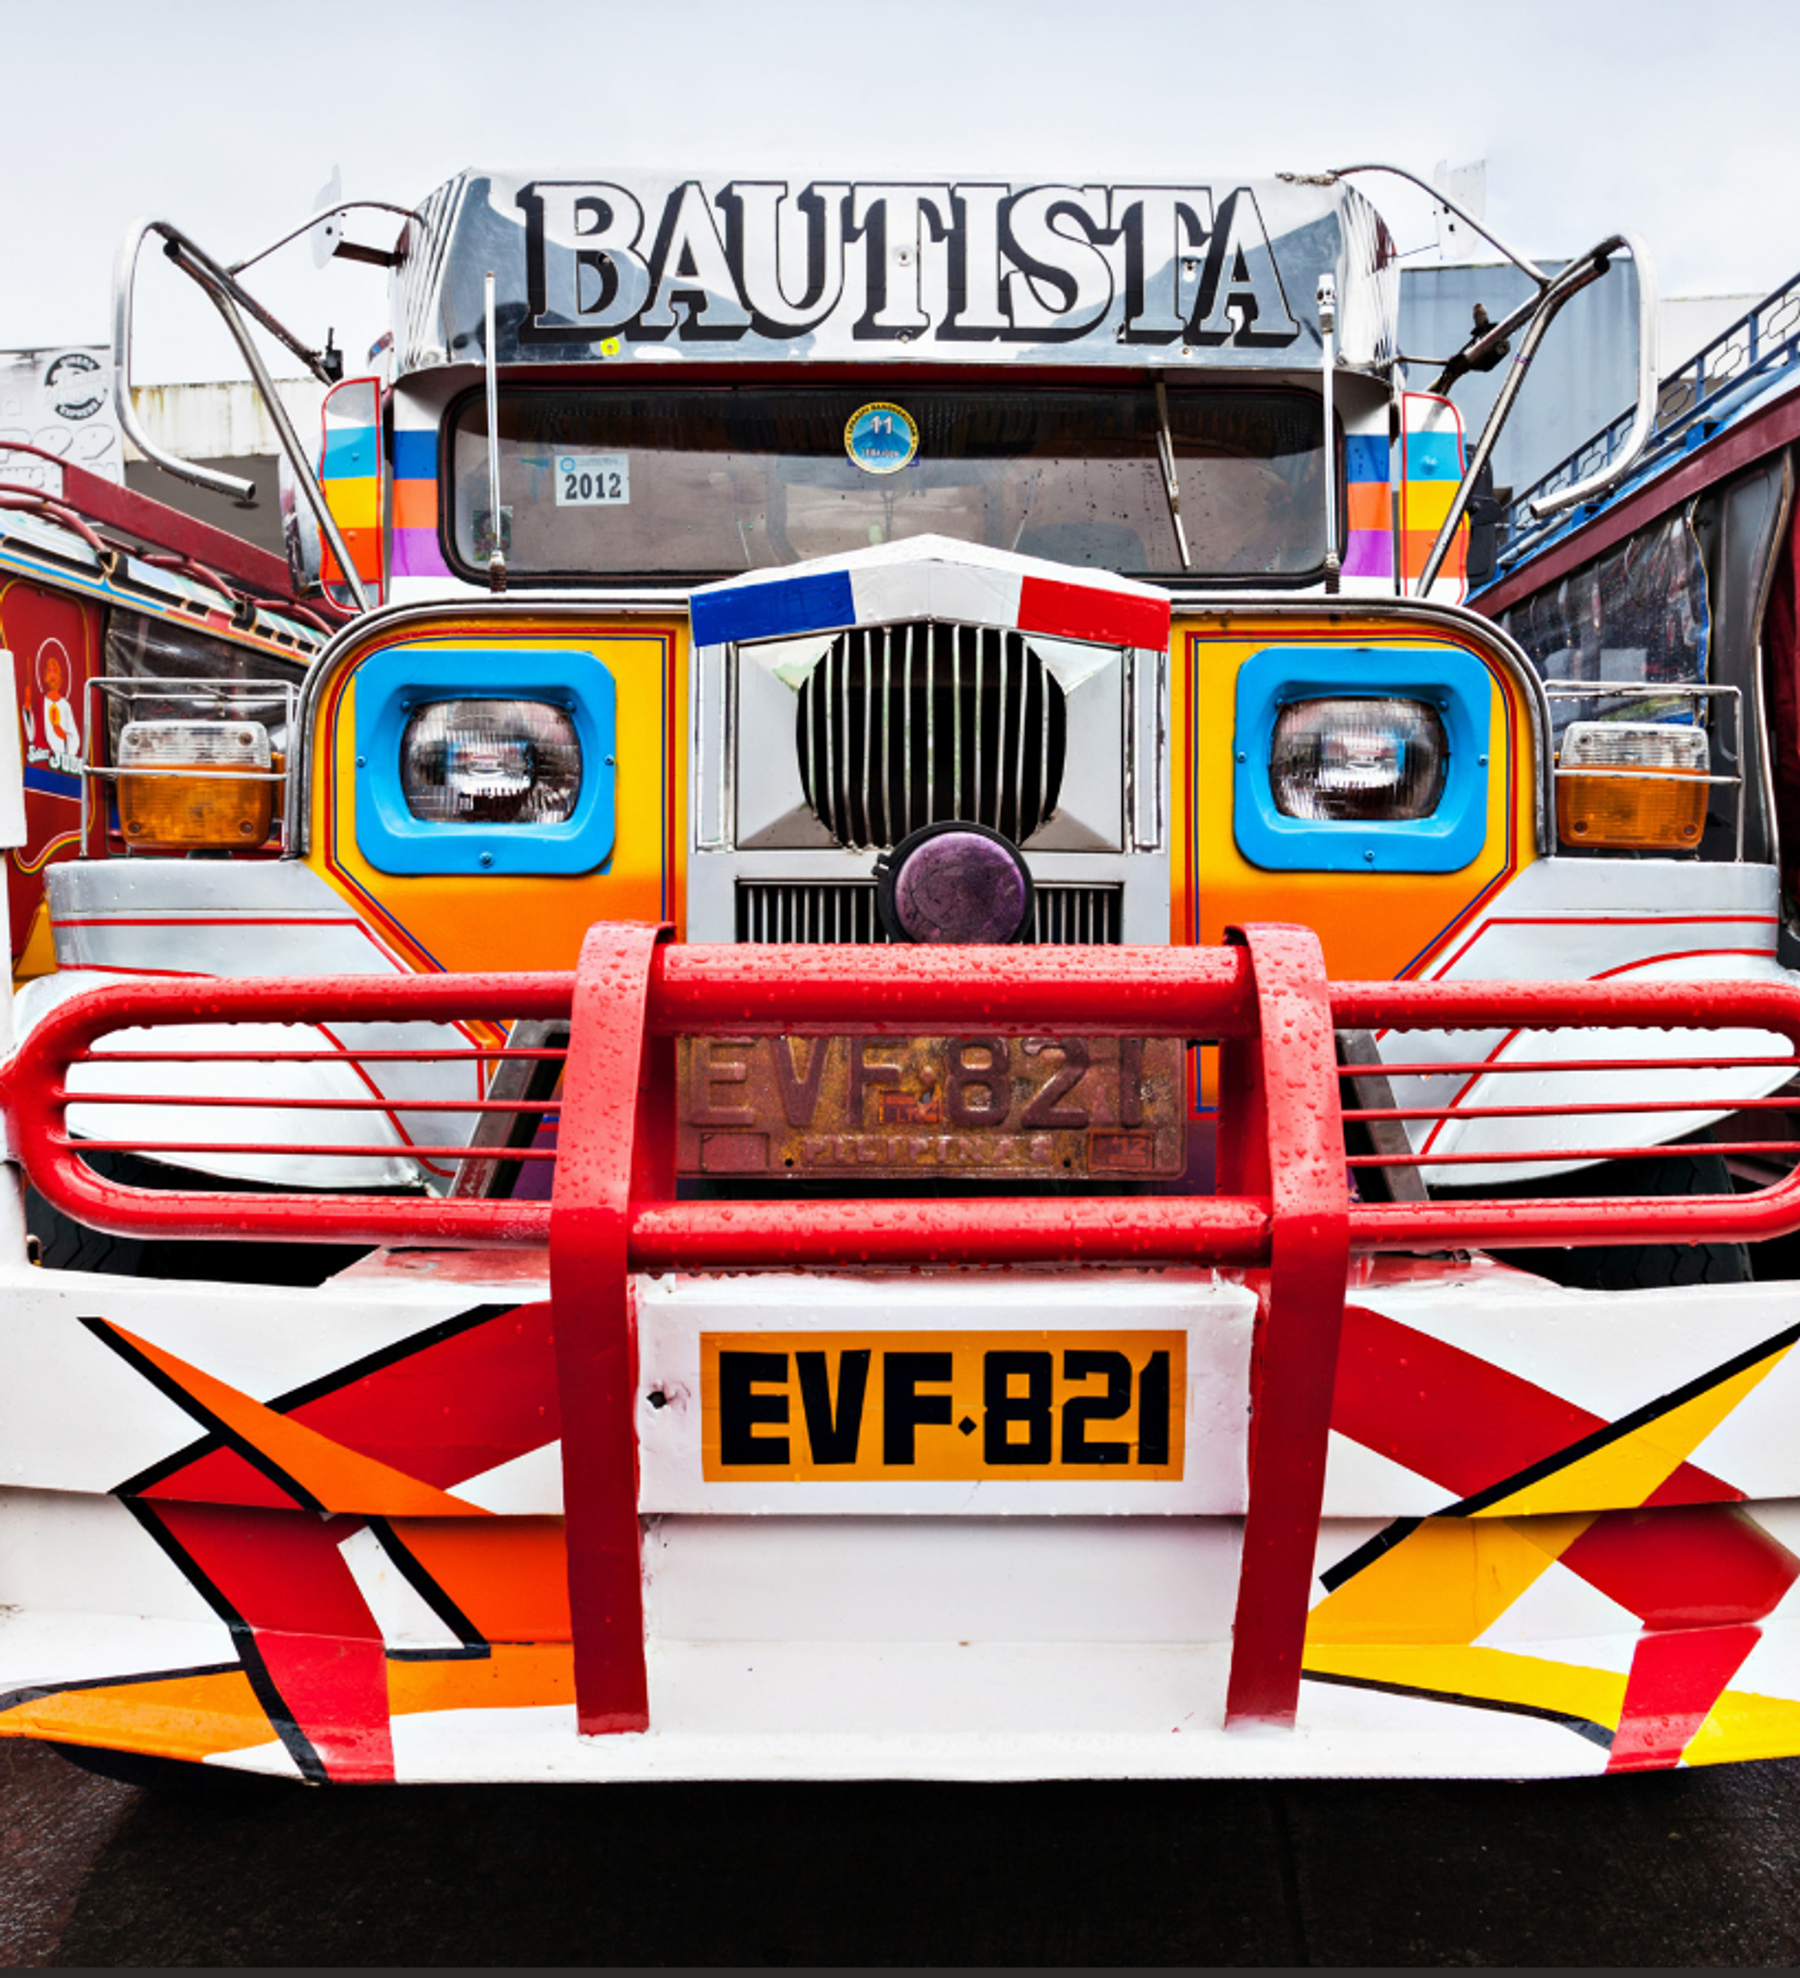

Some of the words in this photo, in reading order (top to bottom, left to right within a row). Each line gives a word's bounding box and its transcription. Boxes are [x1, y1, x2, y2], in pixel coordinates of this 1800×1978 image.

[519, 181, 1301, 346] BAUTISTA
[871, 415, 893, 434] 11
[565, 472, 622, 500] 2012
[803, 1135, 1052, 1162] PILIPINAS
